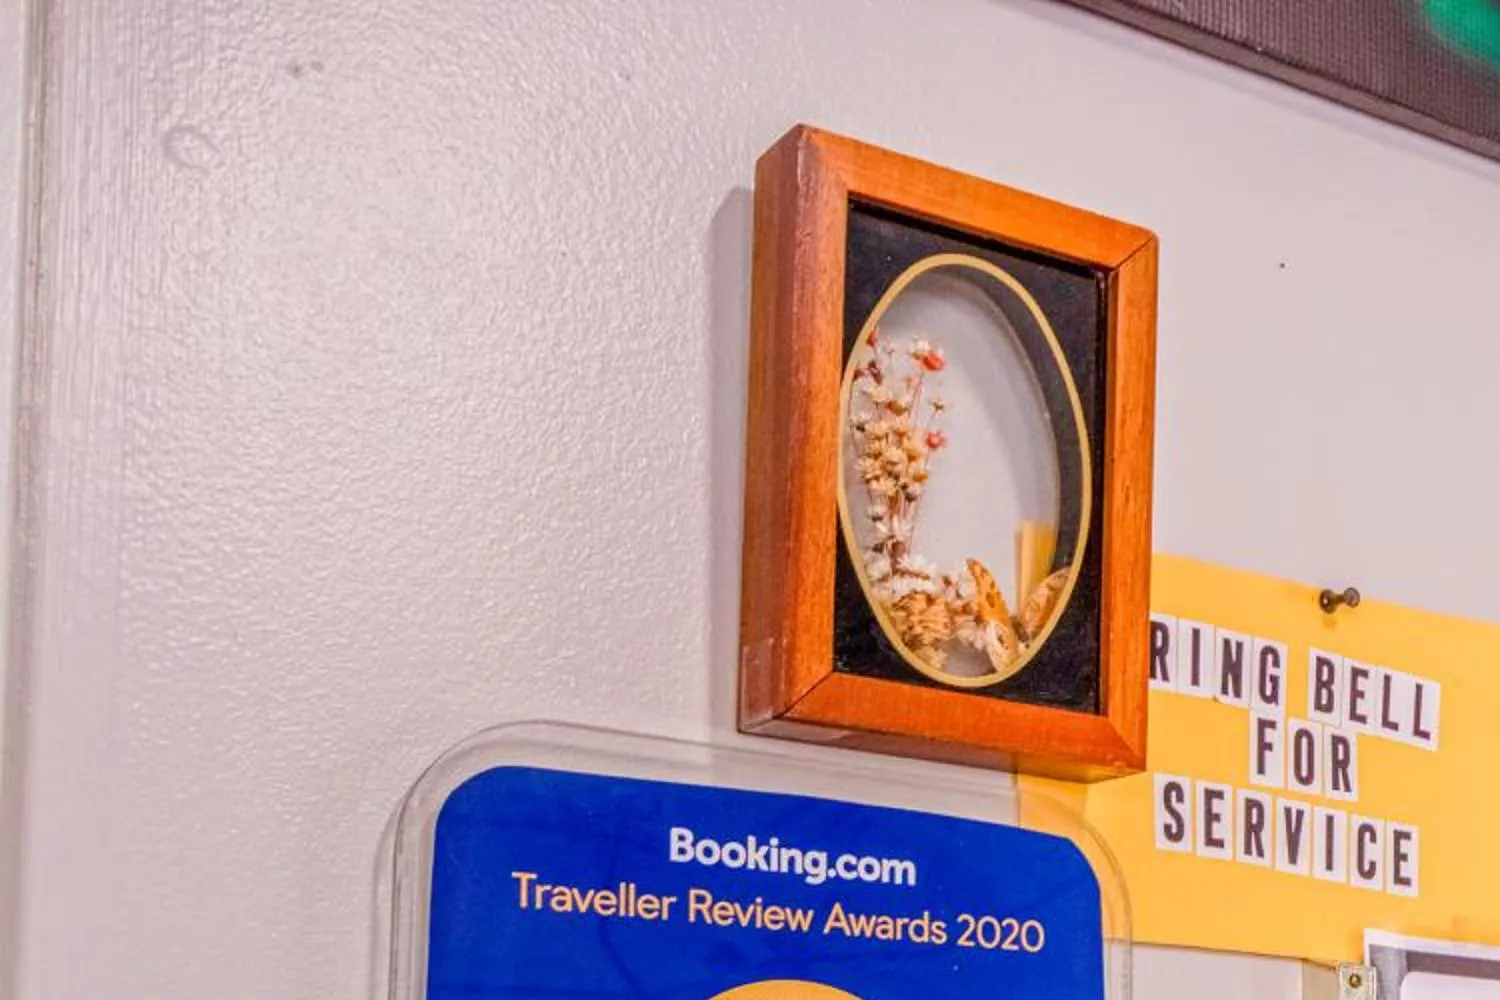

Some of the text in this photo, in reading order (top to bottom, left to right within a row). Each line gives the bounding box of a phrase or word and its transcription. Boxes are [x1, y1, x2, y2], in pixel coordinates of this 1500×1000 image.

[1149, 620, 1432, 741] RING BELL
[1255, 718, 1353, 793] FOR
[668, 826, 917, 886] Booking.com
[1162, 780, 1414, 887] SERVICE
[511, 871, 1046, 953] Traveller Review Awards 2020
